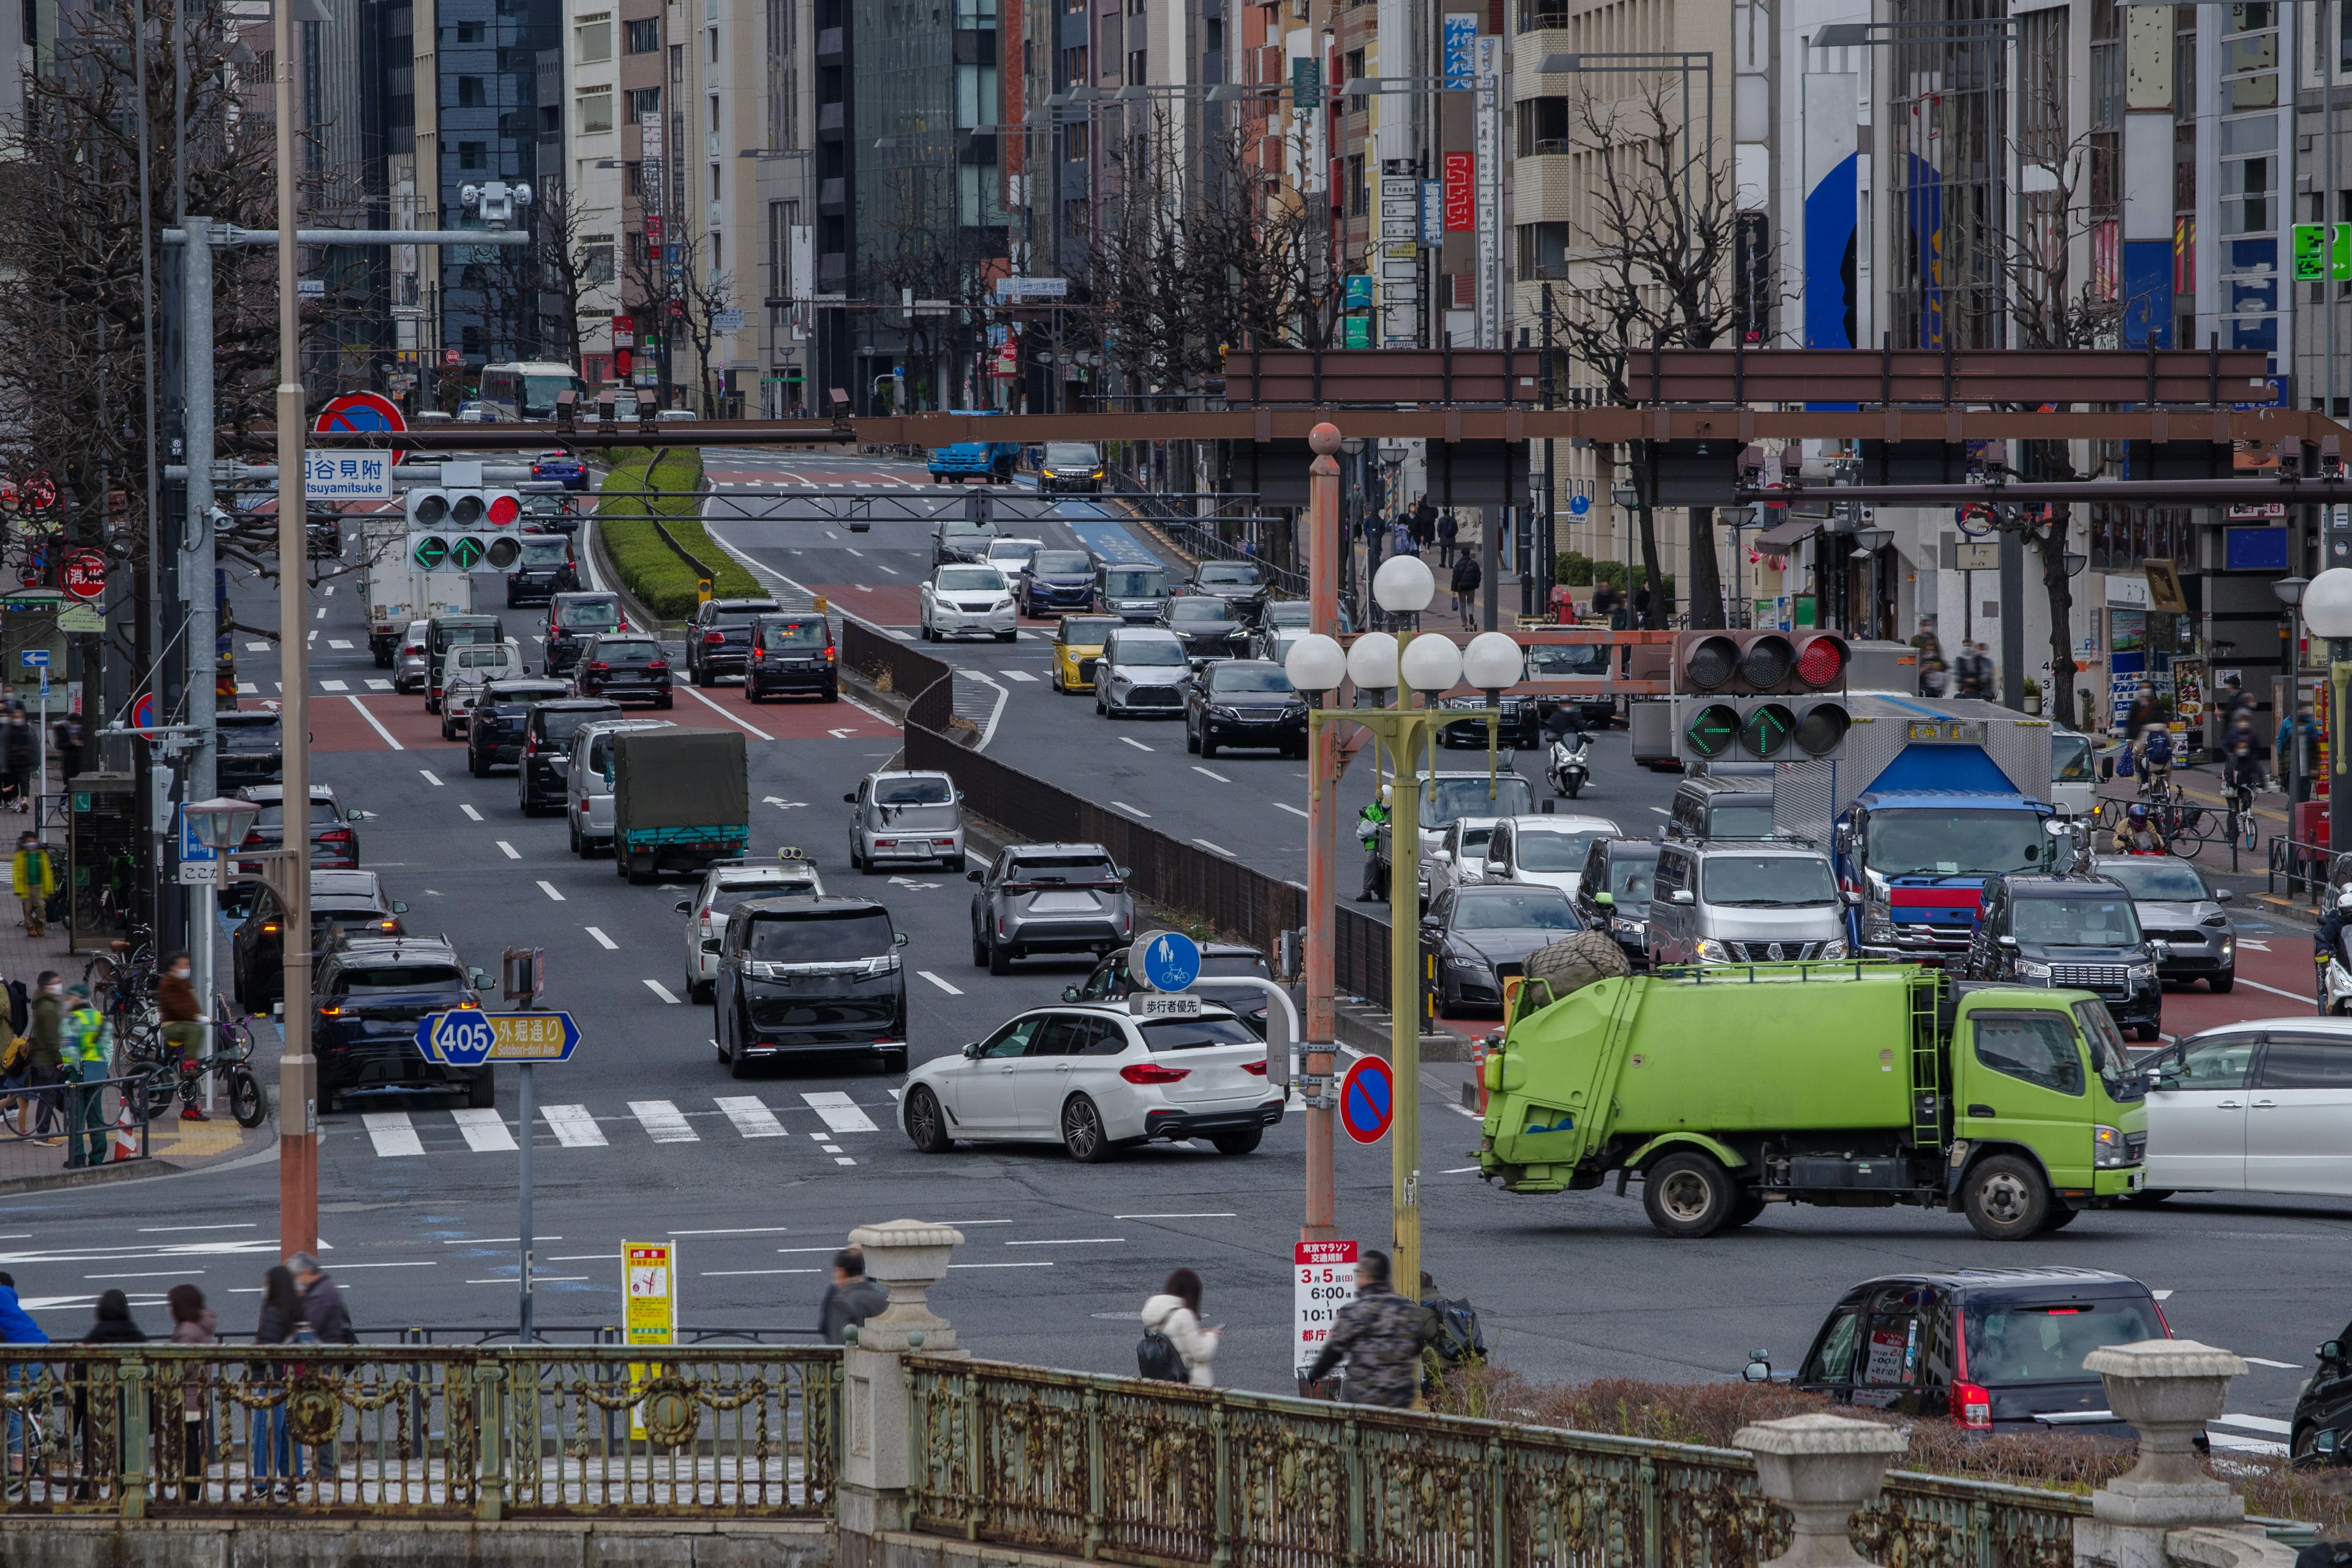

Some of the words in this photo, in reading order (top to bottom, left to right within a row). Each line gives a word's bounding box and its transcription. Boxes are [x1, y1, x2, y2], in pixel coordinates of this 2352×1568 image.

[305, 460, 382, 480] 谷見附
[306, 482, 382, 494] tsuyamitsuke
[2041, 662, 2050, 671] 4
[2043, 680, 2050, 689] 3
[189, 843, 208, 853] 専用
[1147, 1000, 1197, 1014] 歩行者優先
[440, 1024, 488, 1052] 405
[499, 1019, 559, 1042] 外堀通り
[498, 1044, 541, 1056] Sotobori-dori
[544, 1044, 557, 1055] Ave.
[1303, 1243, 1350, 1253] 東京マラソン
[1311, 1253, 1343, 1263] 交通規制
